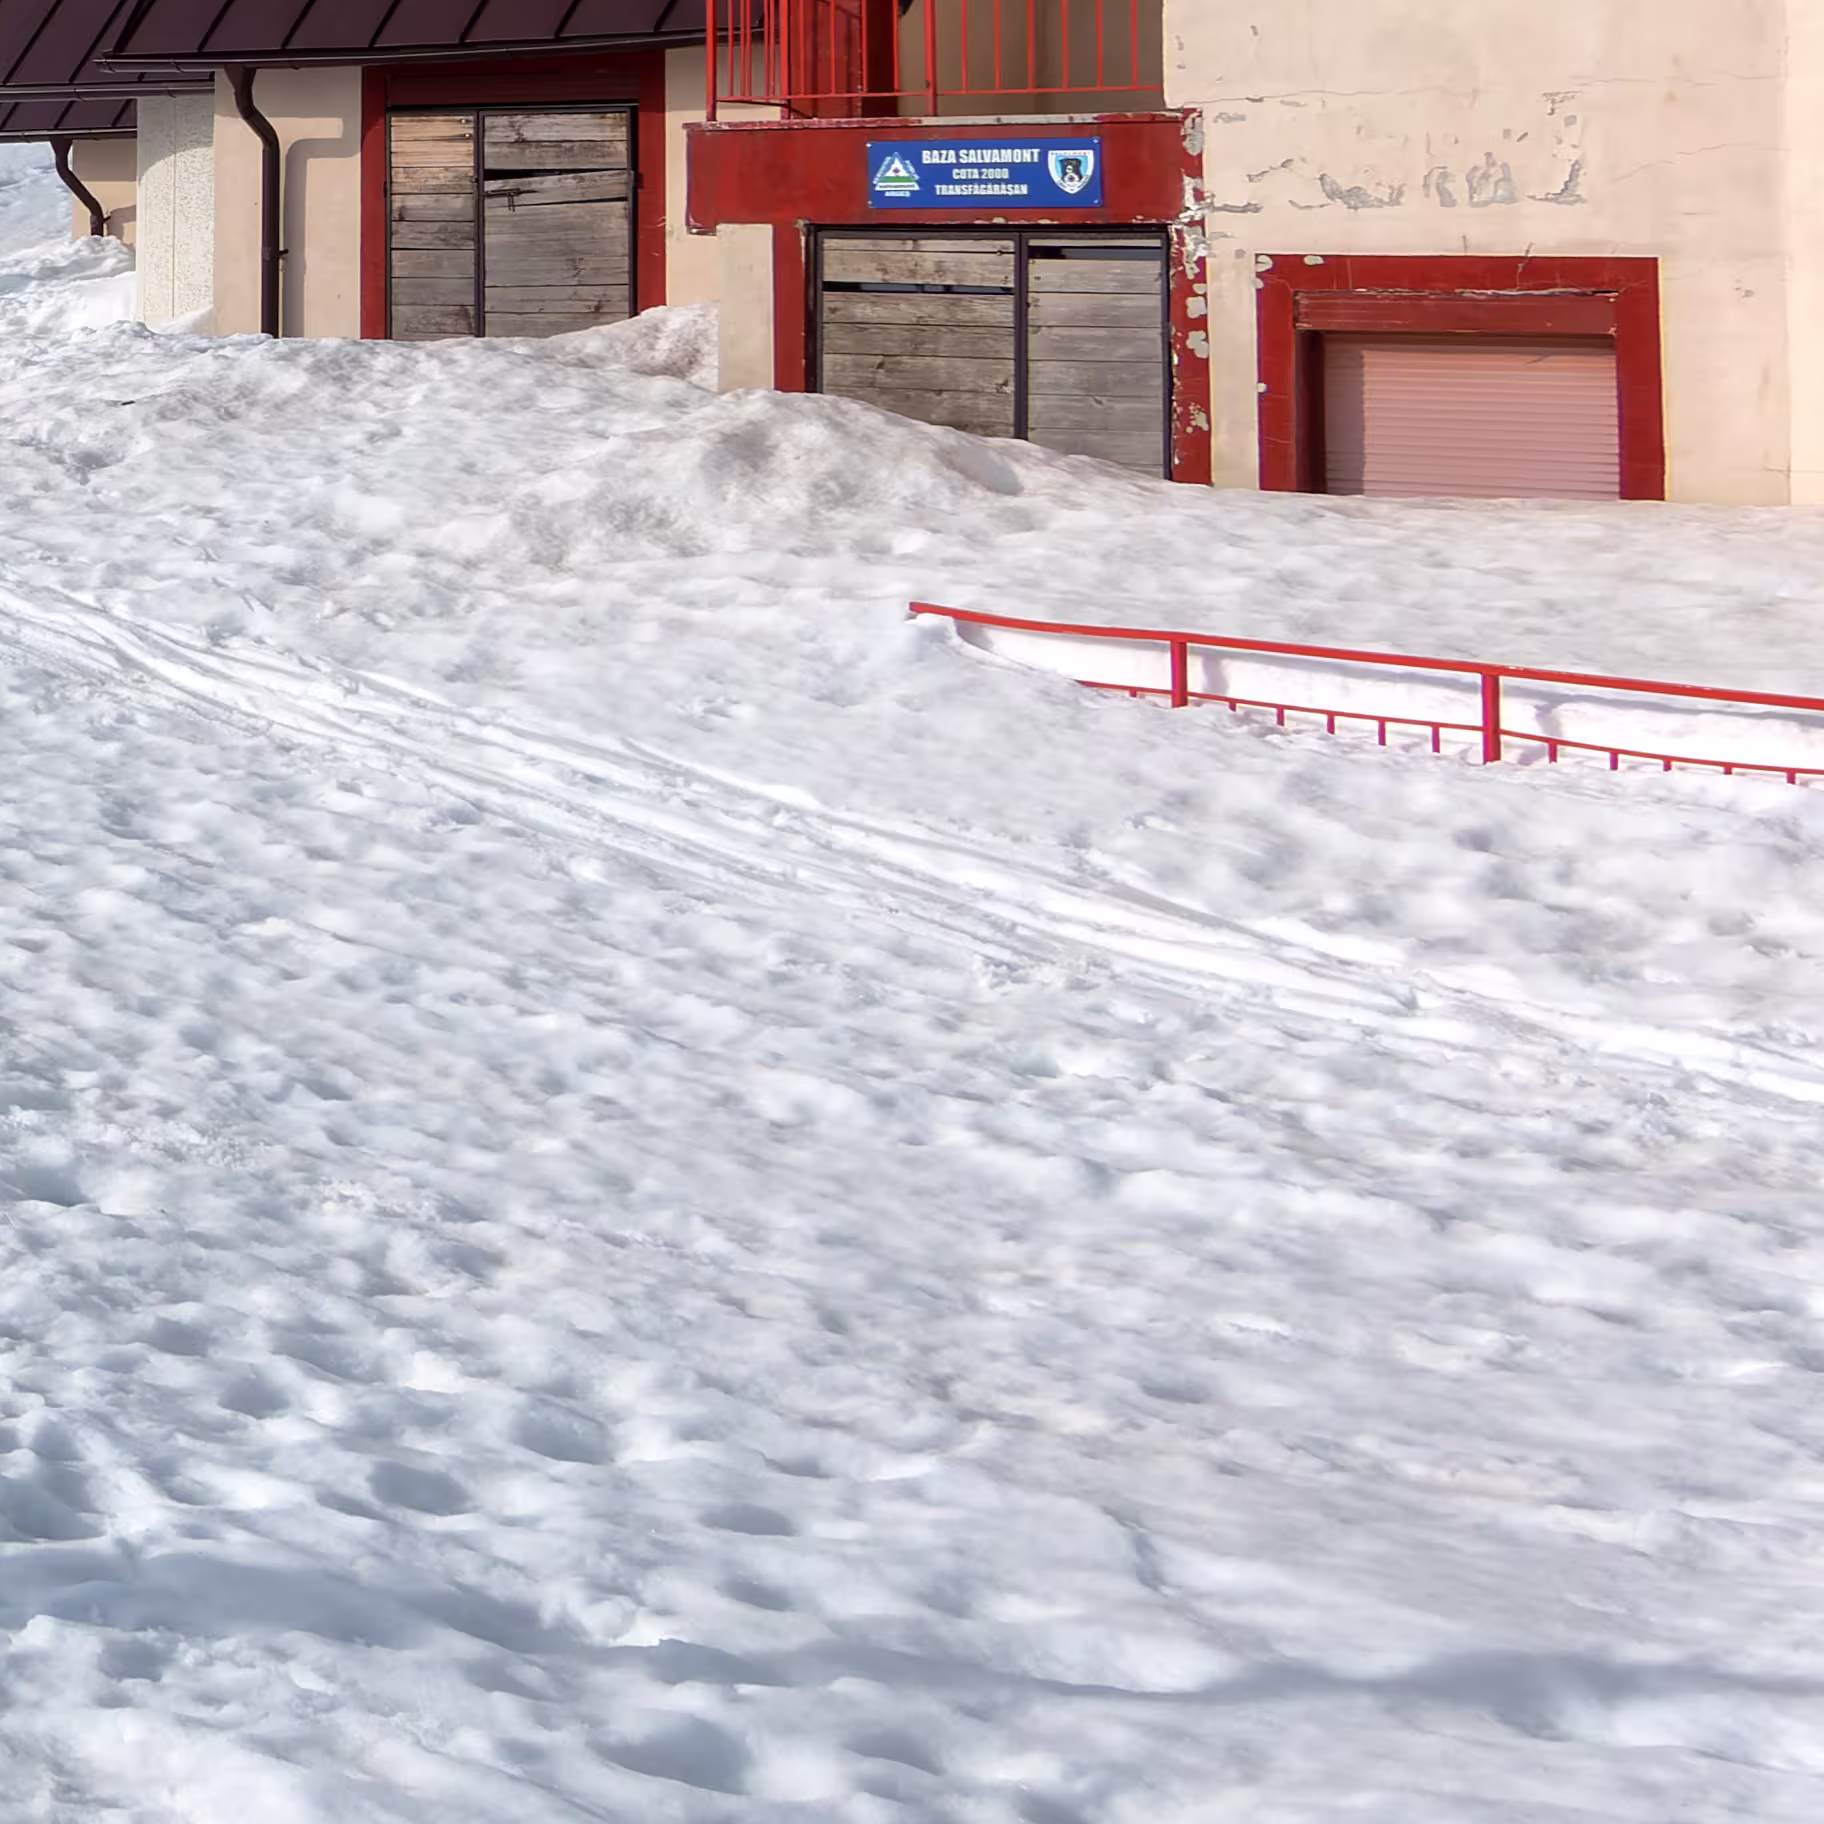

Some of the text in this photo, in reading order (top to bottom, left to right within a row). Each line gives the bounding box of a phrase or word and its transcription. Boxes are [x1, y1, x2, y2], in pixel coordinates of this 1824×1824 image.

[922, 149, 1040, 164] BAZA SALVAMONT
[952, 168, 1009, 179] COTA 2000
